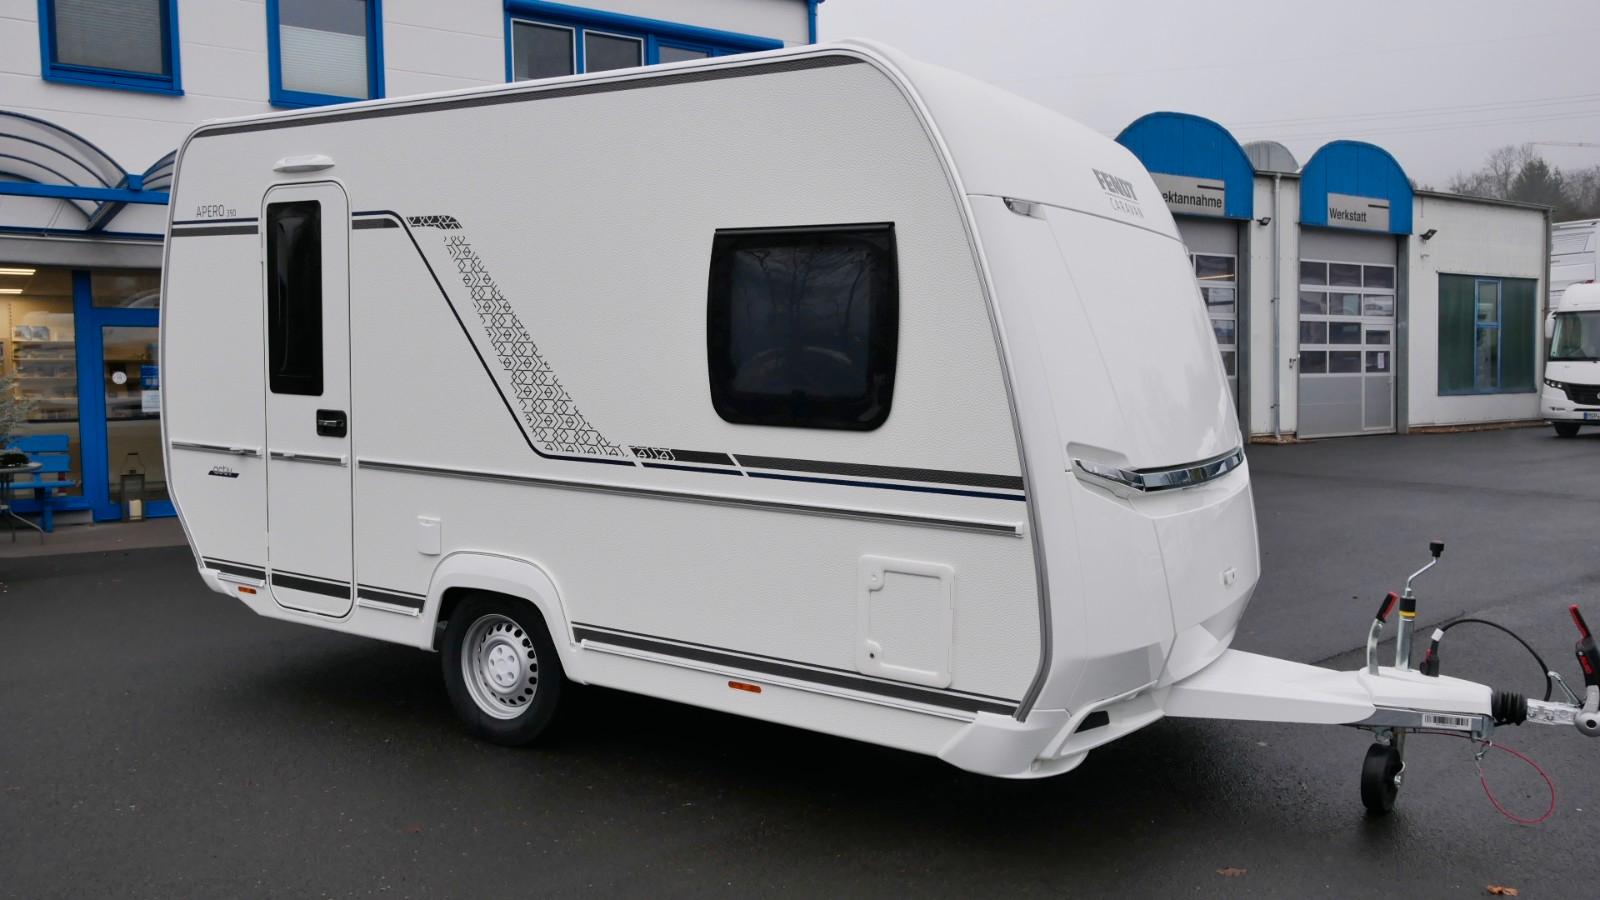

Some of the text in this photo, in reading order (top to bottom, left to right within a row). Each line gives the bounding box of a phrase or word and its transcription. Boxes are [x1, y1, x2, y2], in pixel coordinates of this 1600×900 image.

[1092, 168, 1138, 201] FENDT
[1162, 191, 1223, 209] ektannahme
[196, 204, 225, 218] APERO
[1329, 207, 1367, 223] Werkstatt
